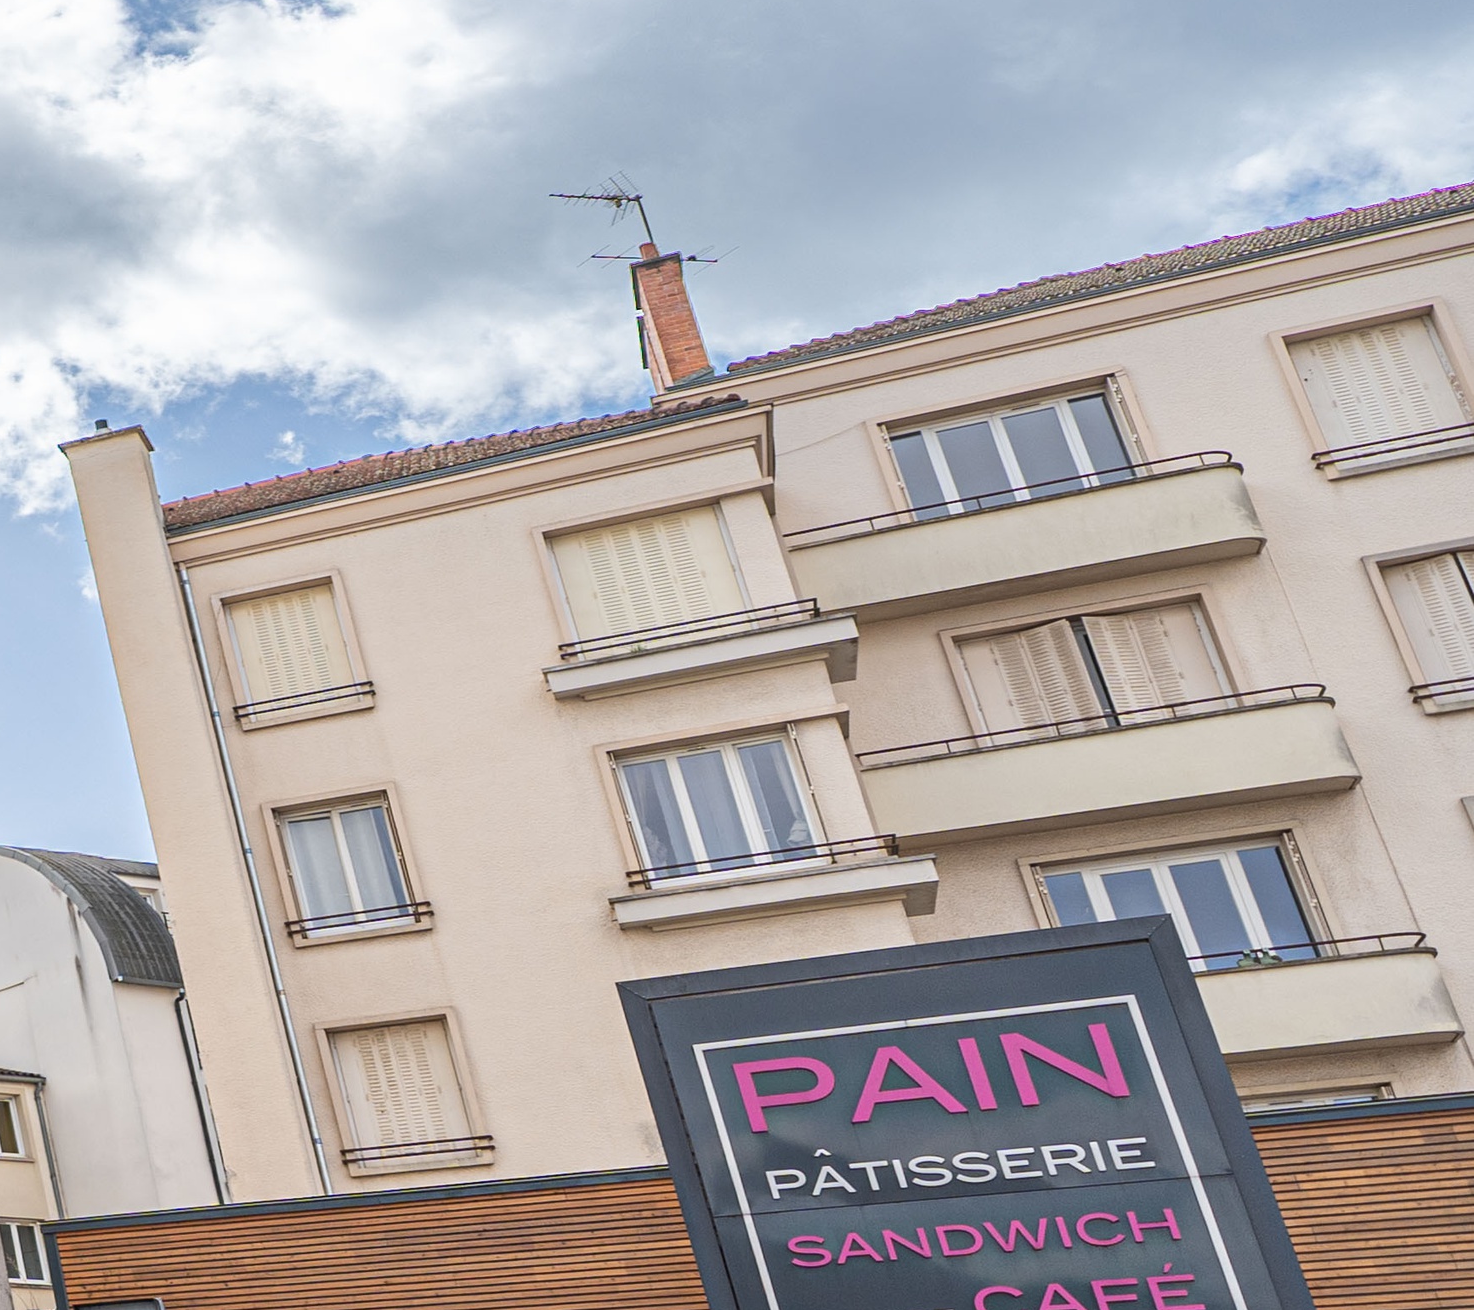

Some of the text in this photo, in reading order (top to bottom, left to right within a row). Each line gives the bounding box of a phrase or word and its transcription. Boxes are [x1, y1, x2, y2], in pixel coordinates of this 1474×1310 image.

[732, 1021, 1131, 1134] PAIN
[764, 1136, 1157, 1200] PÂTISSERIE
[786, 1207, 1183, 1268] SANDWICH
